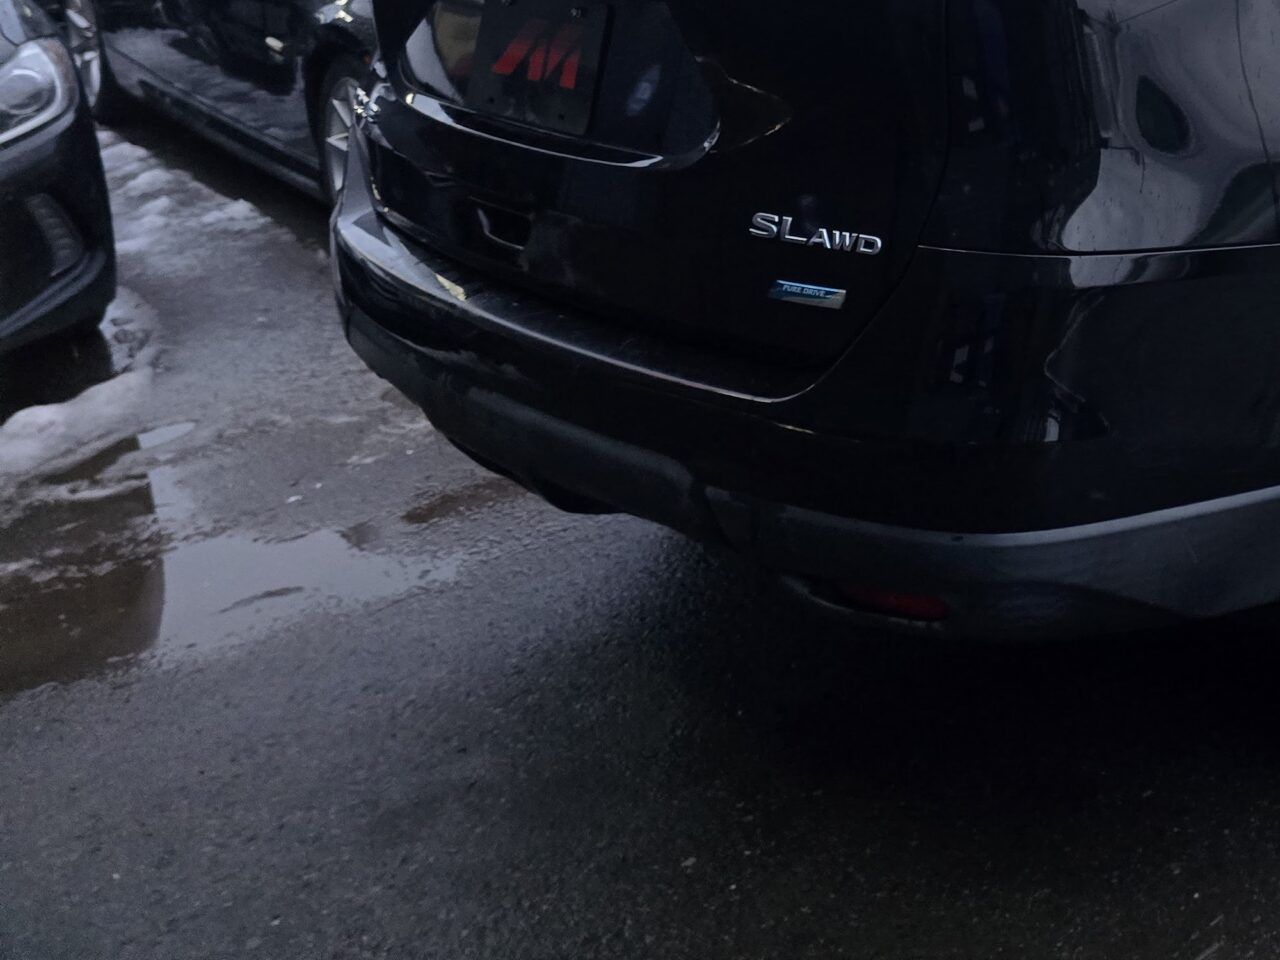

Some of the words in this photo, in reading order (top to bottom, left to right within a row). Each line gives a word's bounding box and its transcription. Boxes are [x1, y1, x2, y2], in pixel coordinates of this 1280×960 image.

[749, 212, 807, 245] SL
[807, 228, 882, 256] AWD
[782, 284, 802, 294] PURE
[803, 287, 826, 298] DRIVE
